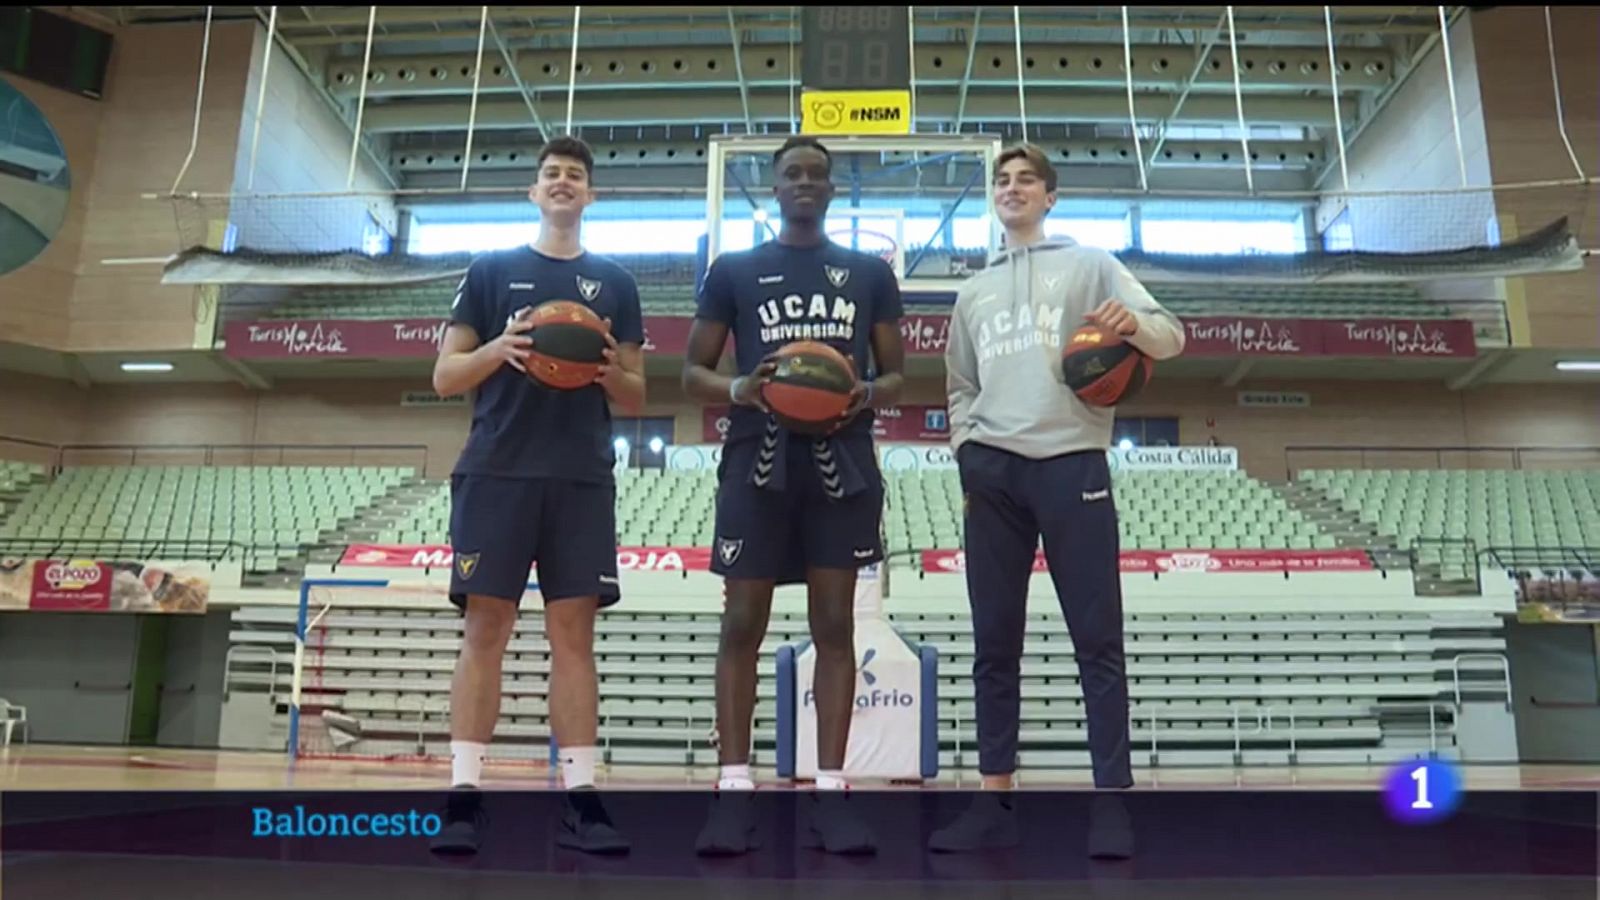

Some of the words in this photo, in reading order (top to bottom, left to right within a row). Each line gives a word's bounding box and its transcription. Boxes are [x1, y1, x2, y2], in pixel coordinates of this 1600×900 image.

[849, 107, 901, 121] #NSM
[757, 293, 857, 327] UCAM
[760, 322, 854, 343] UNIVERSIDAD
[1125, 448, 1172, 465] Costa
[1178, 447, 1232, 465] Cálida
